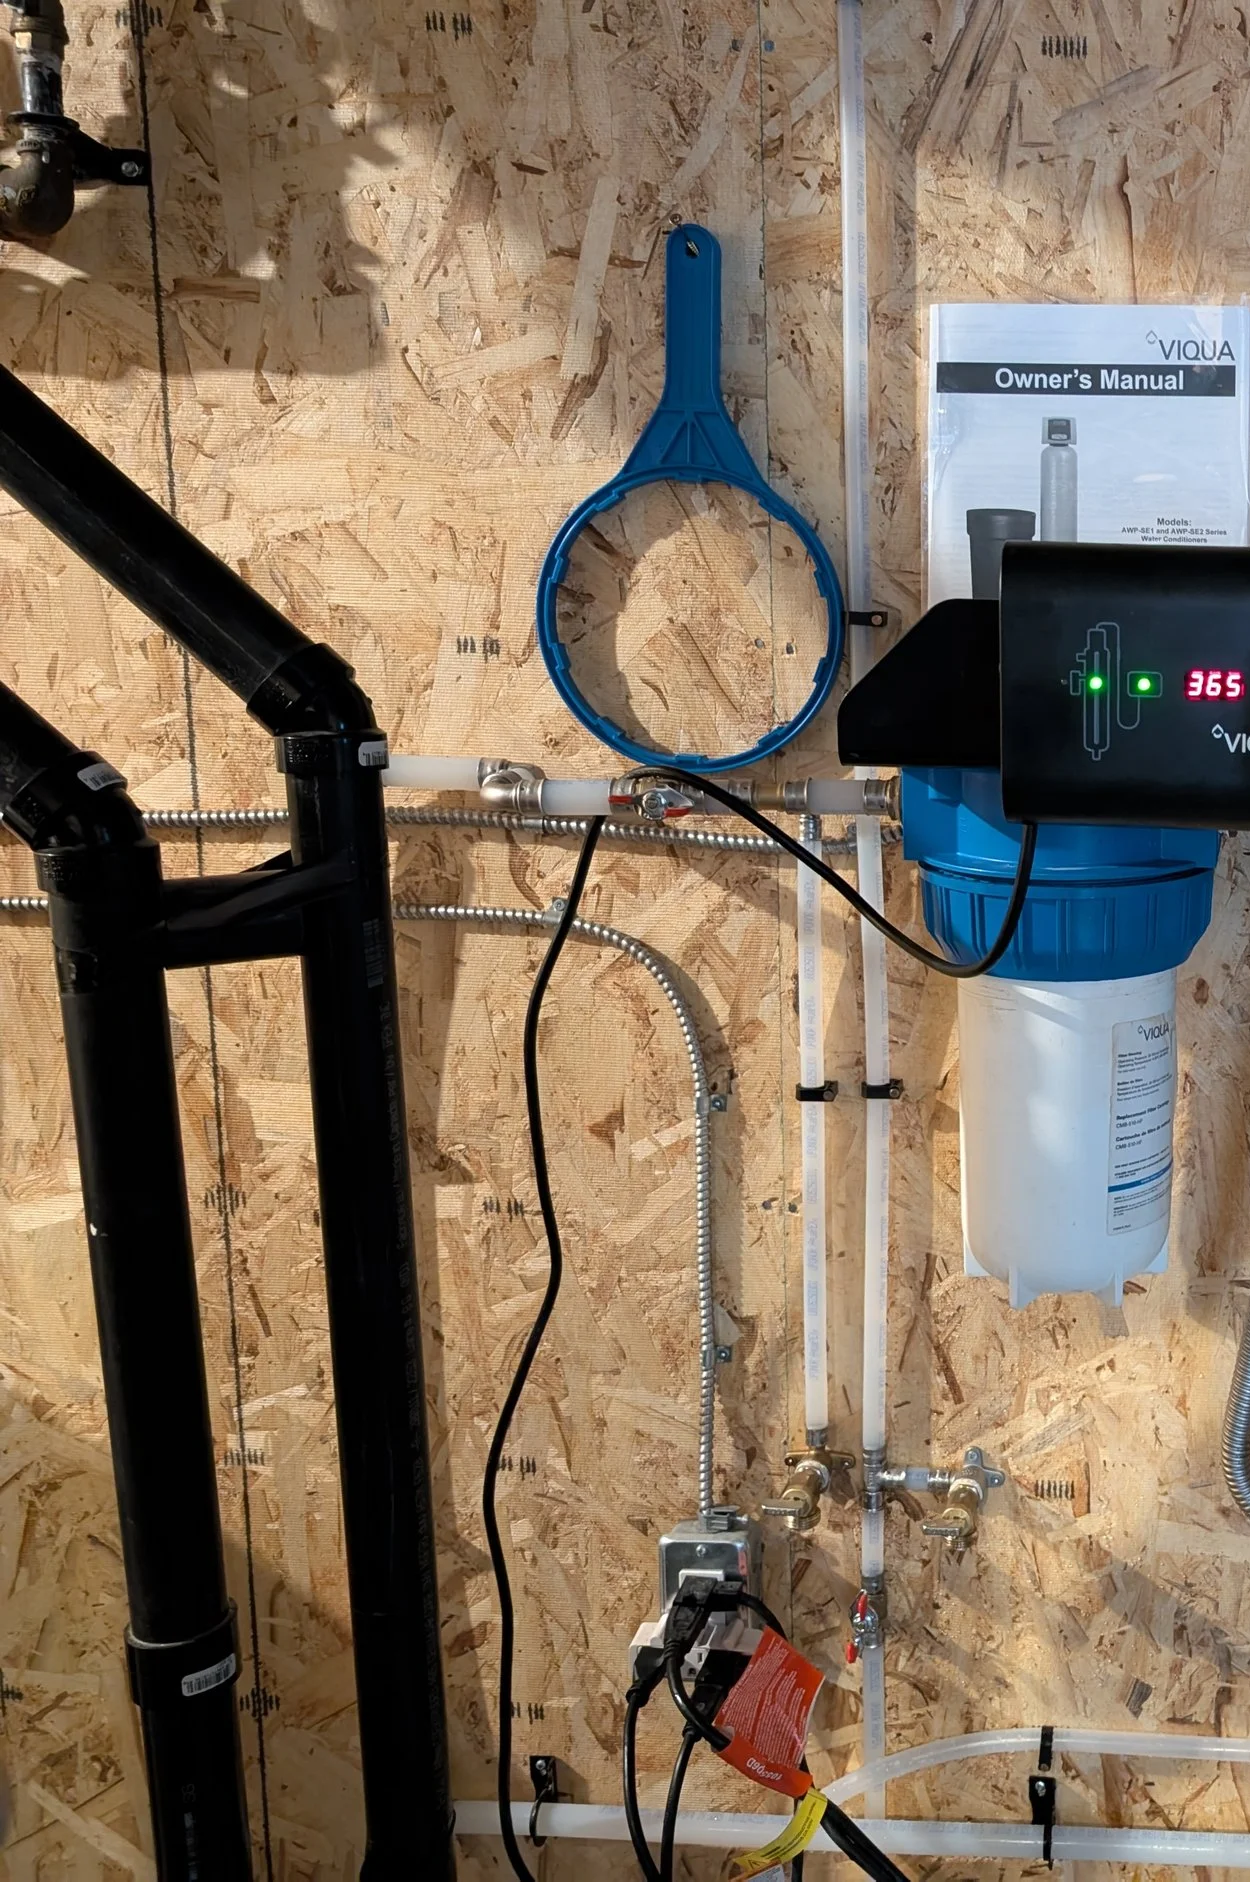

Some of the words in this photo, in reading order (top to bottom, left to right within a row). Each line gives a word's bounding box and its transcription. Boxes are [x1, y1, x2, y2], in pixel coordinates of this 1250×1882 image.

[1158, 340, 1235, 361] VIQUA
[1100, 369, 1184, 391] Manual
[1156, 527, 1169, 535] and
[1171, 528, 1204, 536] AWP-SE2
[1157, 518, 1191, 527] Models:
[1163, 535, 1208, 543] Conditioners
[1187, 671, 1241, 697] 365
[1144, 1022, 1170, 1041] VIQUA
